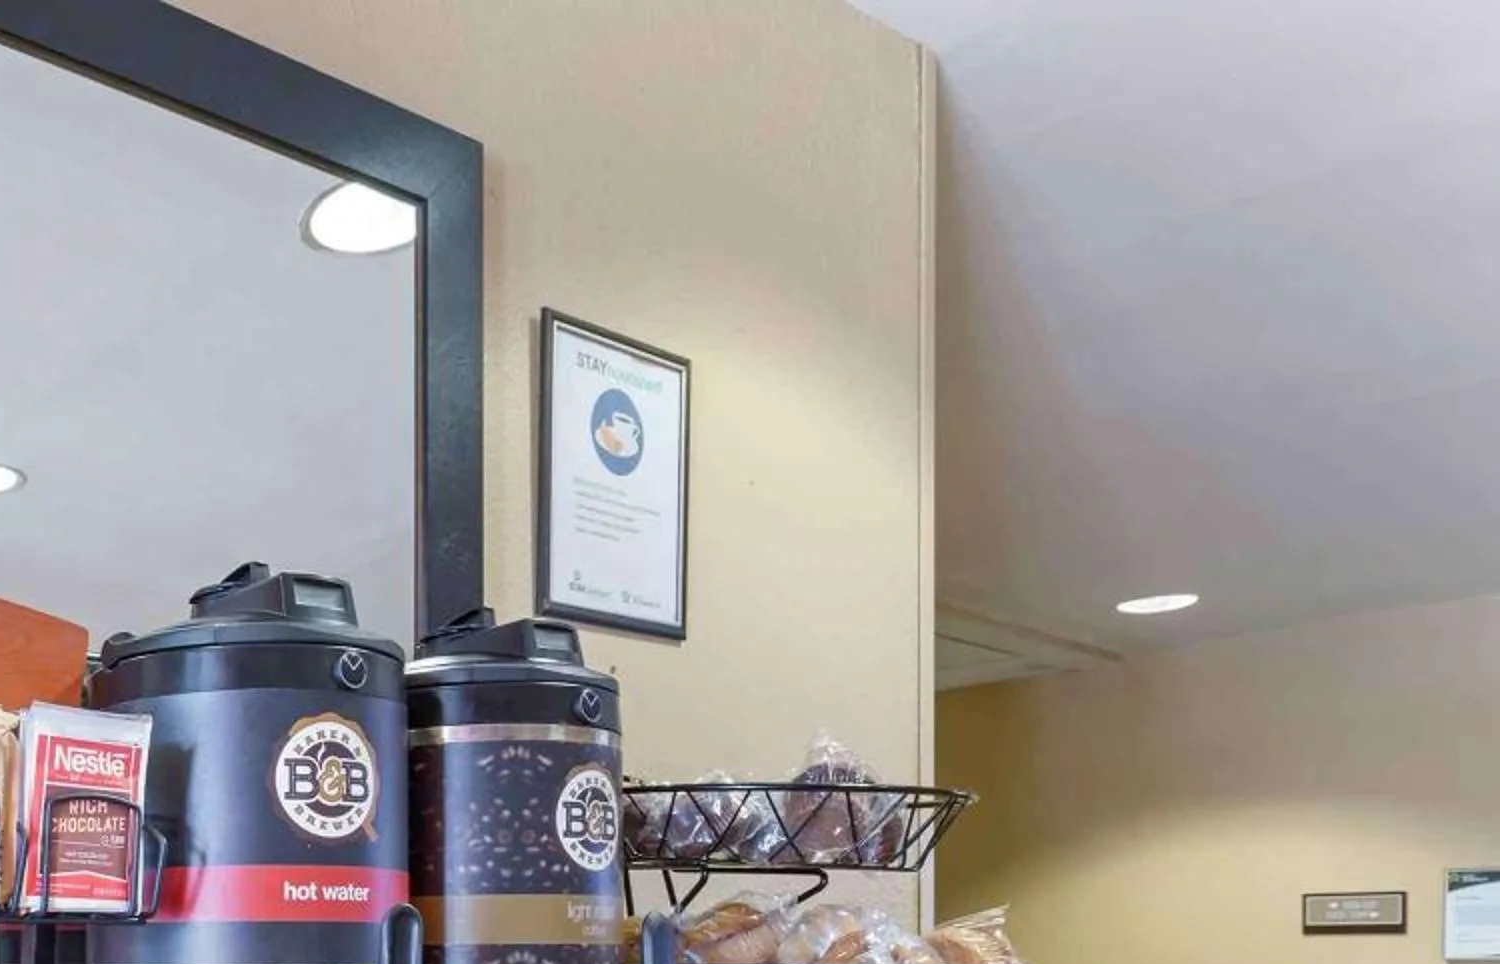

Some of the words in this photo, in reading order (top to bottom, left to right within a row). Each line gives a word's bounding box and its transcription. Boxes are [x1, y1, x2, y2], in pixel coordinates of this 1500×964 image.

[69, 799, 108, 814] RICH
[283, 880, 318, 901] hot
[322, 883, 370, 901] water
